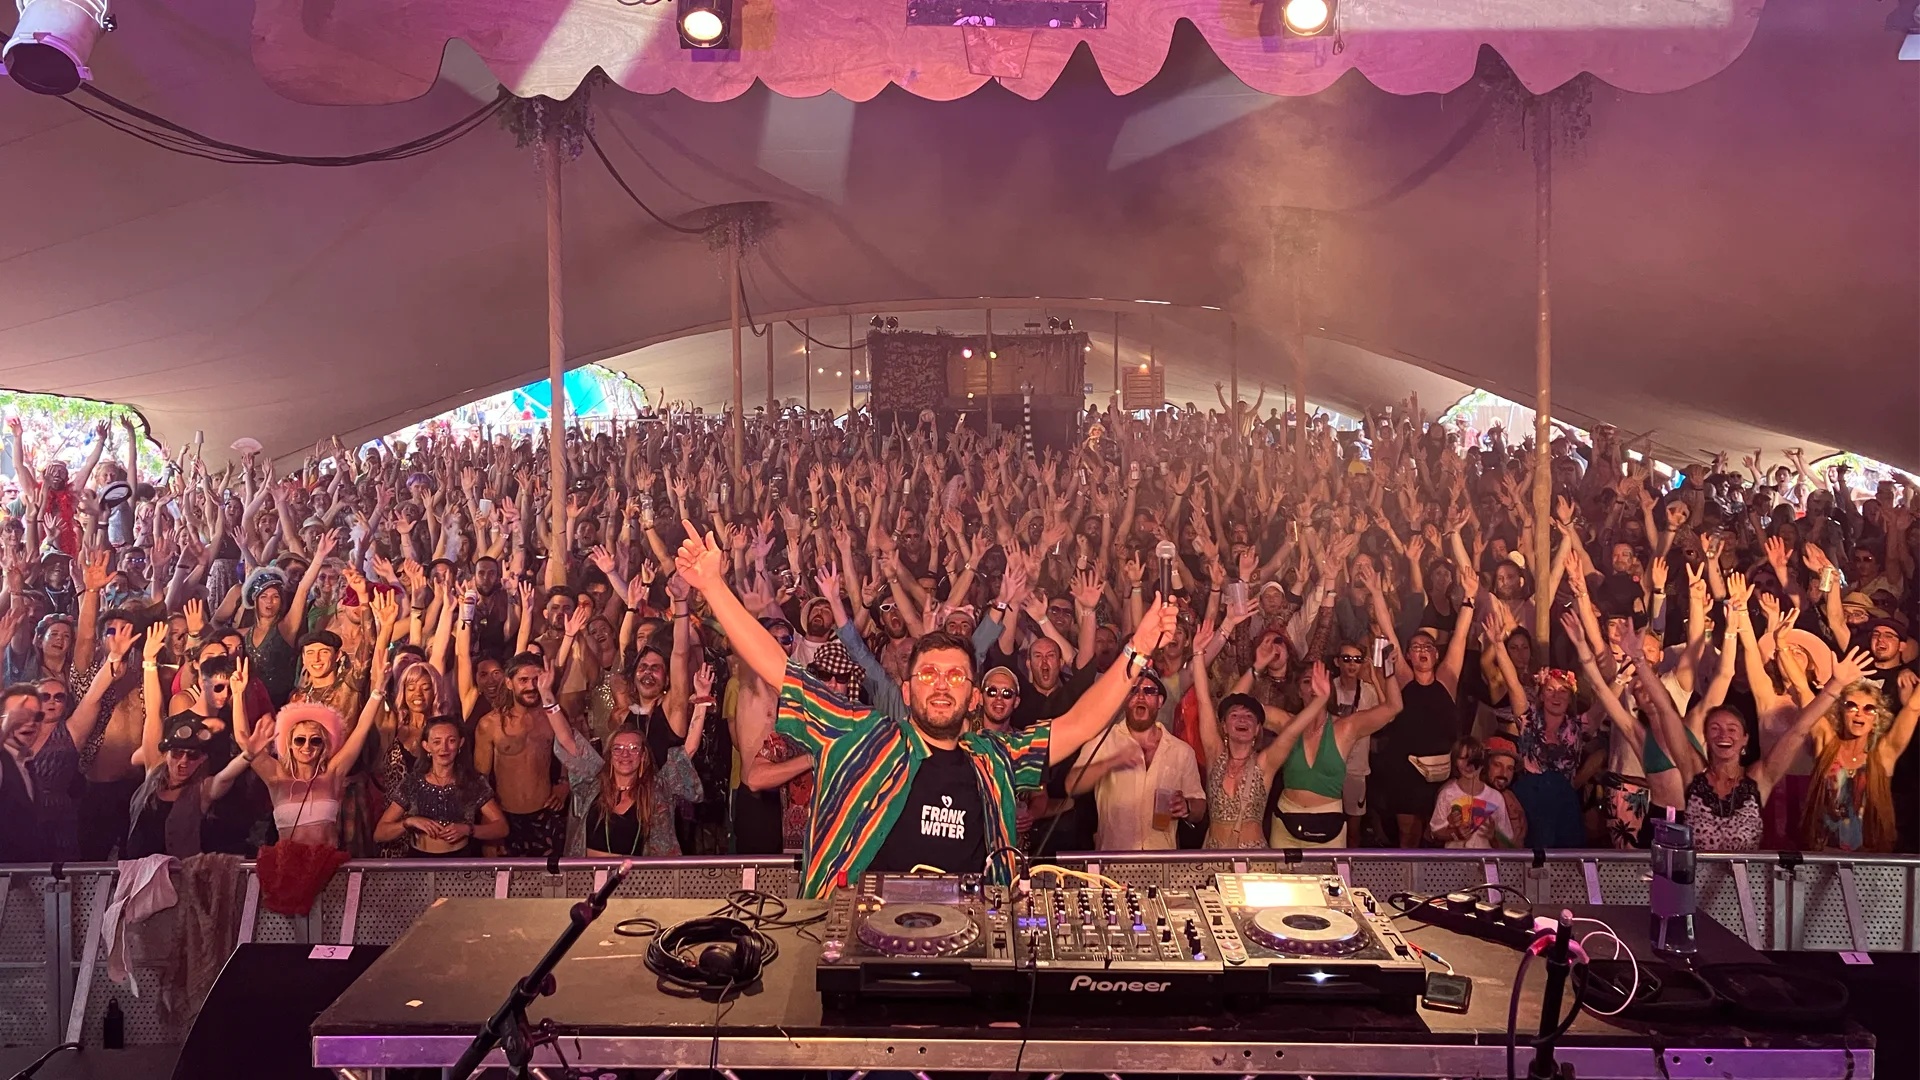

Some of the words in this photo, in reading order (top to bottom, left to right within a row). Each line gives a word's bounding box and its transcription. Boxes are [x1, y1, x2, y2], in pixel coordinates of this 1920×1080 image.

[922, 804, 966, 825] FRANK
[921, 820, 965, 840] WATER
[322, 946, 337, 958] 3
[1070, 975, 1172, 993] Pioneer
